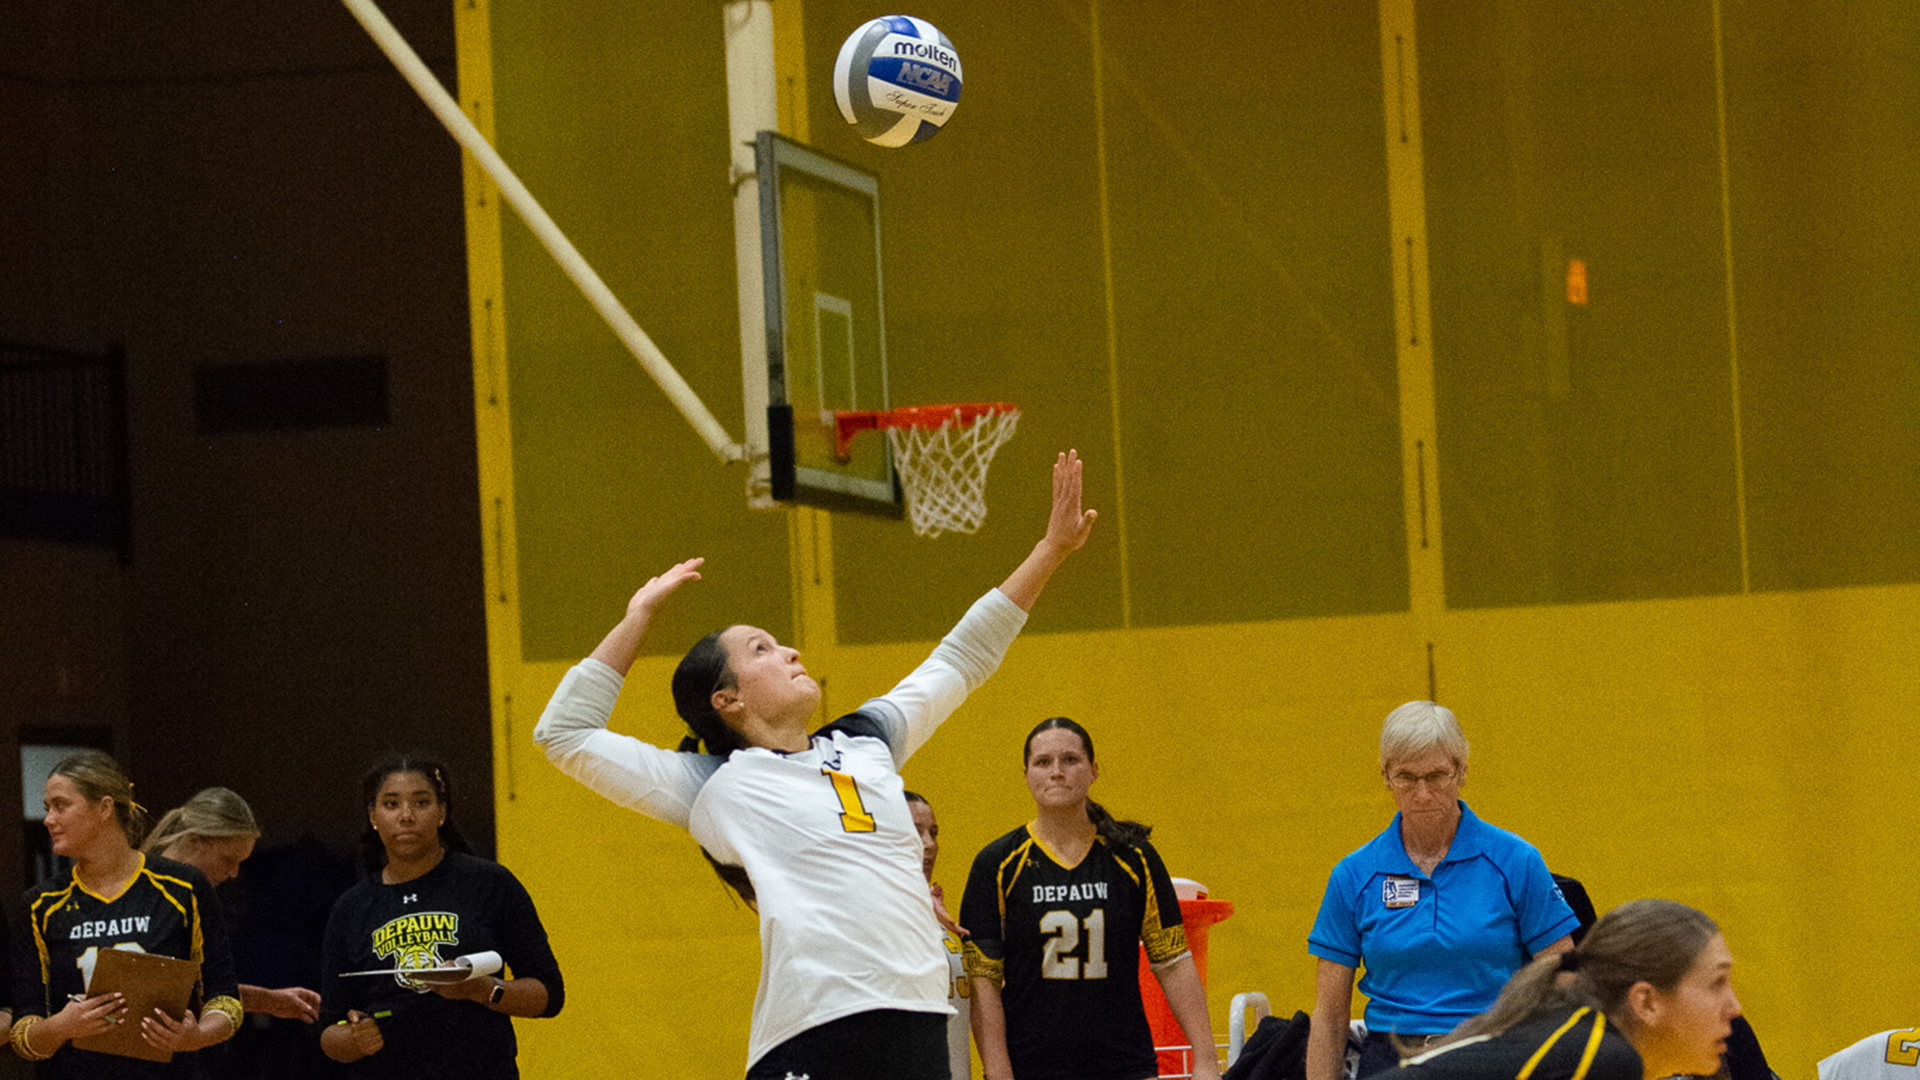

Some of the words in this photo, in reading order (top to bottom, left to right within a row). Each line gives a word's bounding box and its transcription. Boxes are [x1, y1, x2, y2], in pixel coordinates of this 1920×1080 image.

[894, 42, 956, 72] molten
[896, 61, 954, 96] NCAA
[886, 91, 917, 109] Super
[821, 768, 876, 833] 1
[1033, 882, 1108, 903] DEPAUW
[70, 916, 151, 939] DEPAUW
[375, 914, 455, 946] DEPAUW
[378, 930, 456, 957] VOLLEYBALL
[1039, 908, 1108, 980] 21
[76, 942, 146, 995] 1
